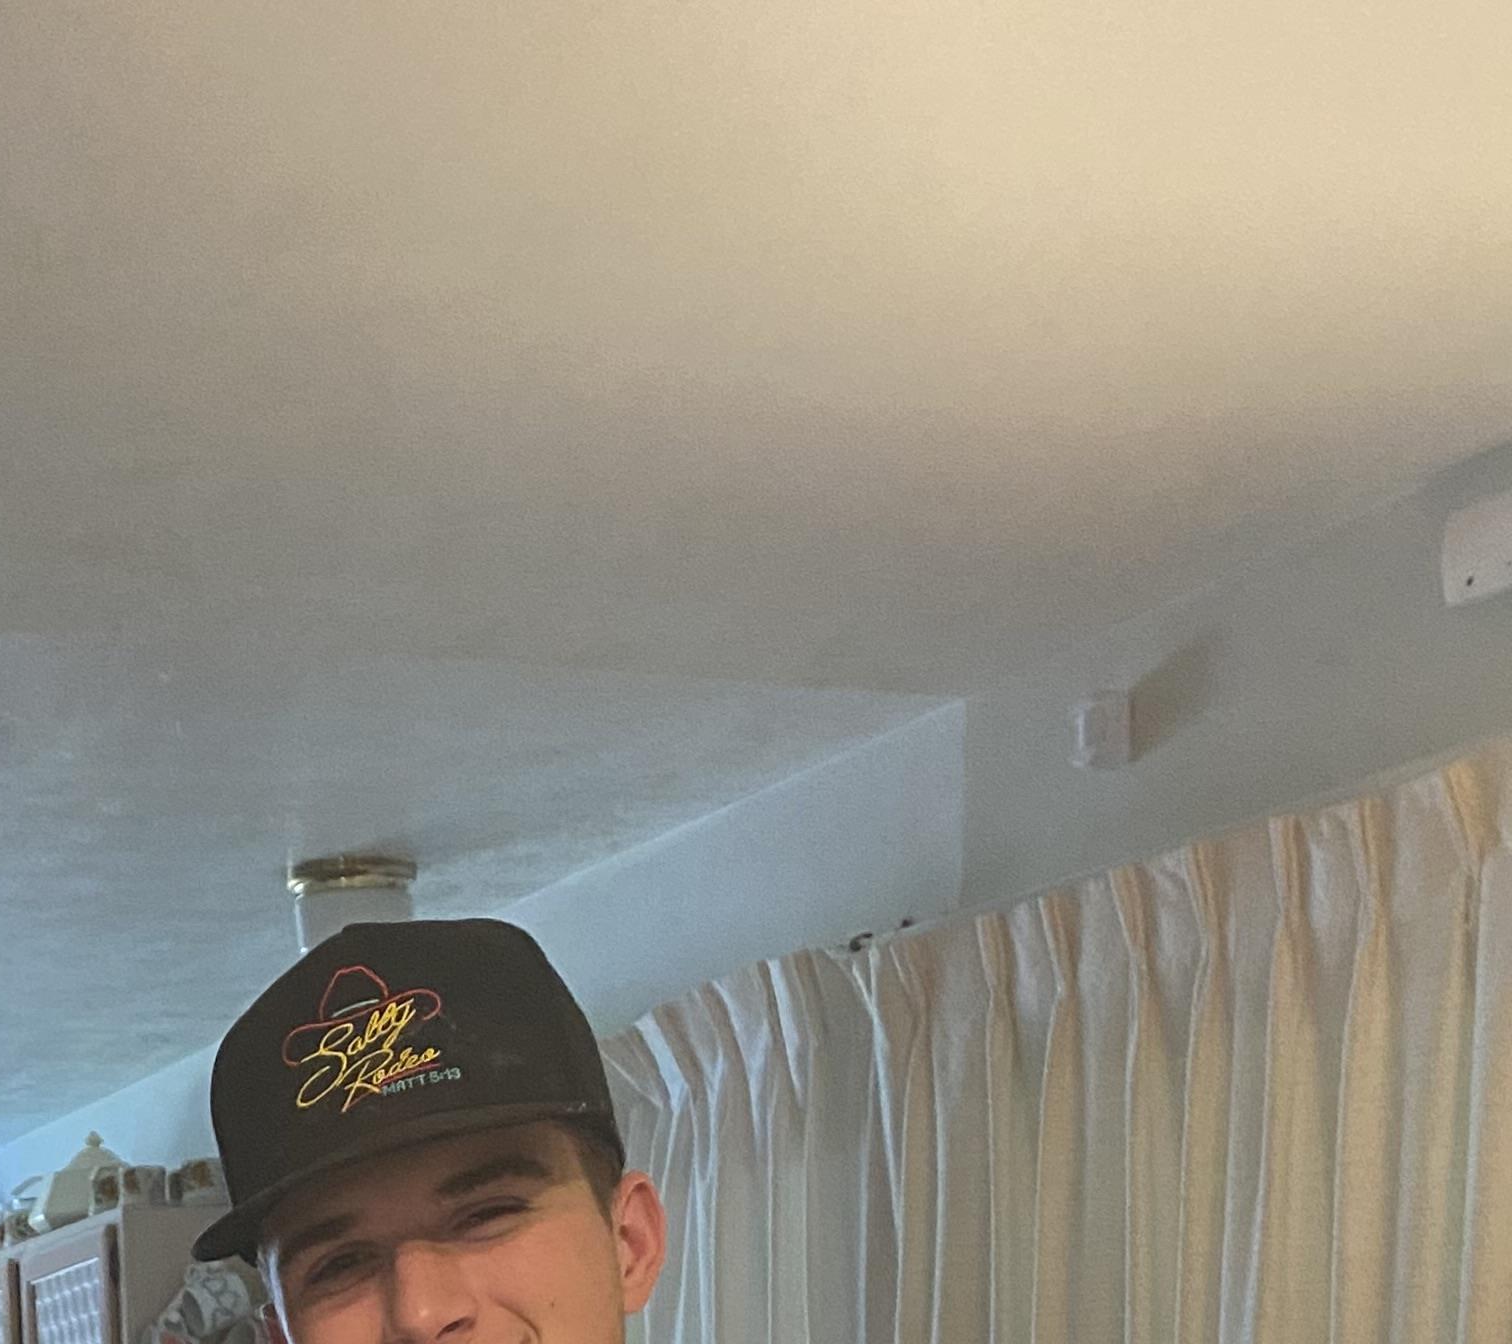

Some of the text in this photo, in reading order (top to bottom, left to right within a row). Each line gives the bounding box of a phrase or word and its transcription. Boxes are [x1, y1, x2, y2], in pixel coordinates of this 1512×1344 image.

[337, 1046, 441, 1113] Rodeo
[381, 1067, 462, 1097] MATT 5:13
